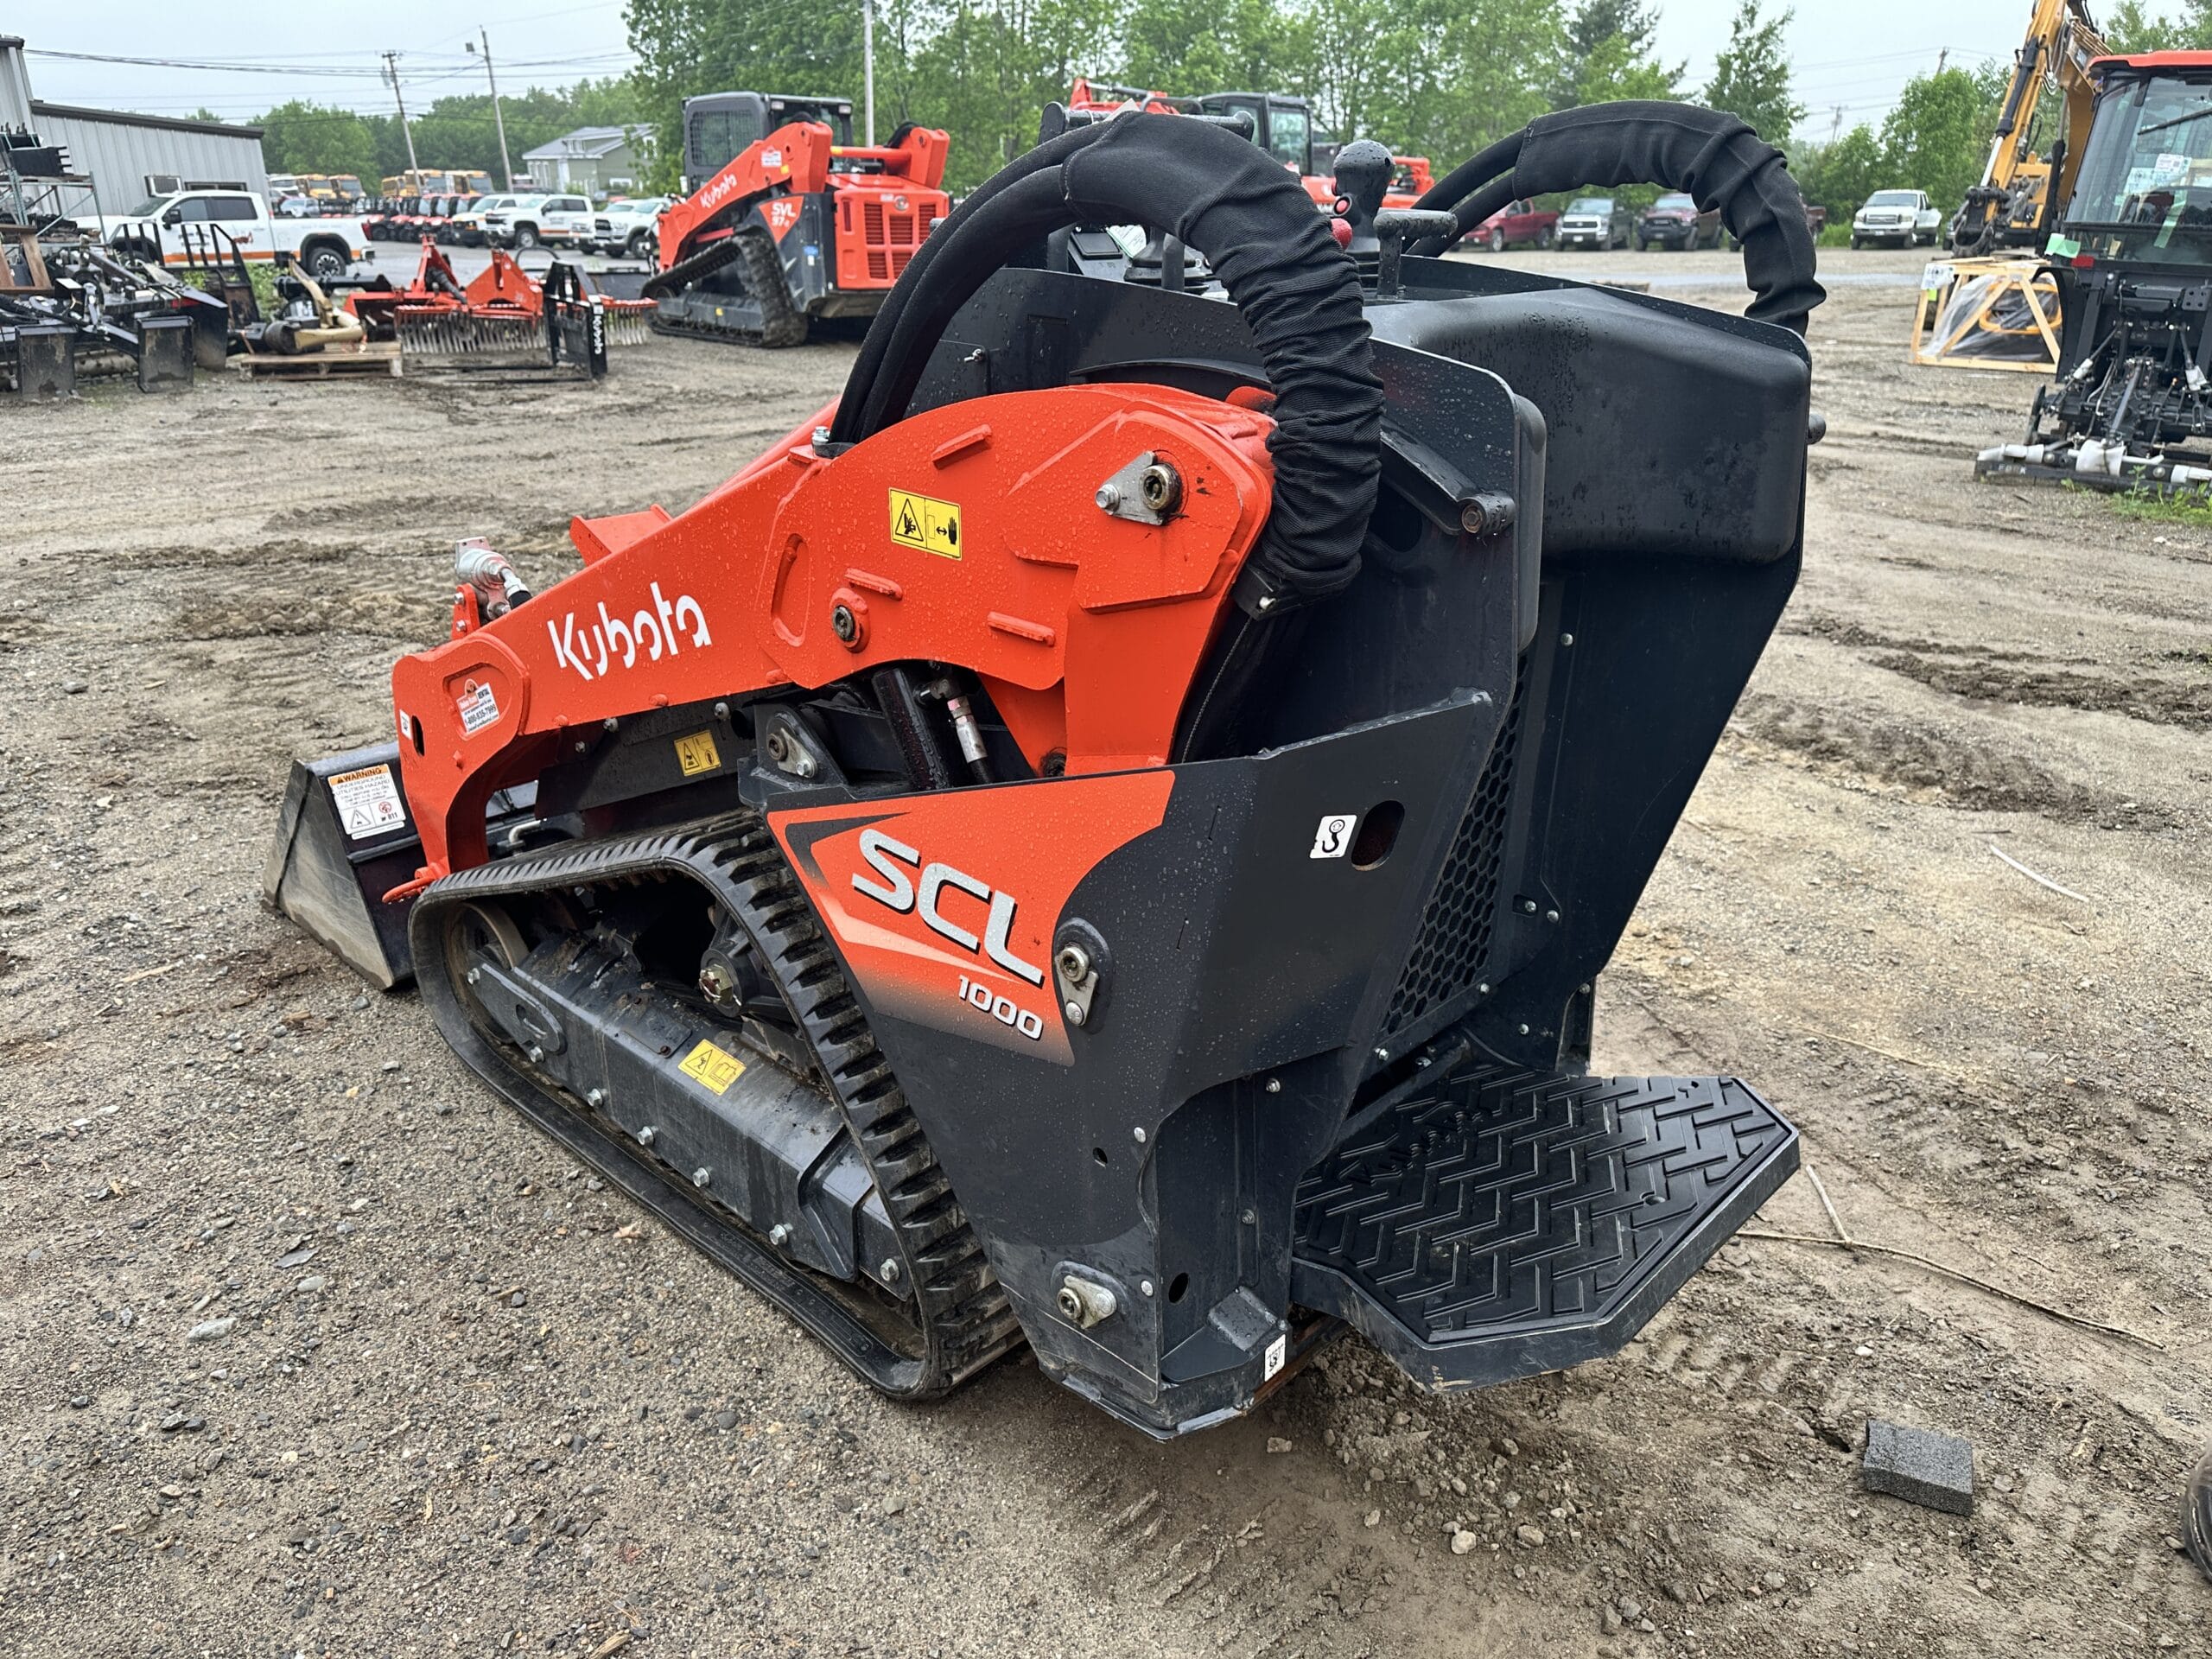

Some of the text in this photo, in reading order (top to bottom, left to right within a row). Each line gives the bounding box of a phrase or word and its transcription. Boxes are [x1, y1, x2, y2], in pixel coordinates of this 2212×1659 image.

[700, 174, 737, 208] Kubota
[772, 202, 796, 217] SVL
[593, 315, 603, 355] Kubota
[547, 582, 712, 681] Kubota
[336, 775, 386, 790] UNDERGROUND
[342, 767, 382, 782] WARNING
[365, 779, 391, 789] HAZARD
[851, 829, 1044, 988] SCL
[958, 974, 1043, 1040] 1000
